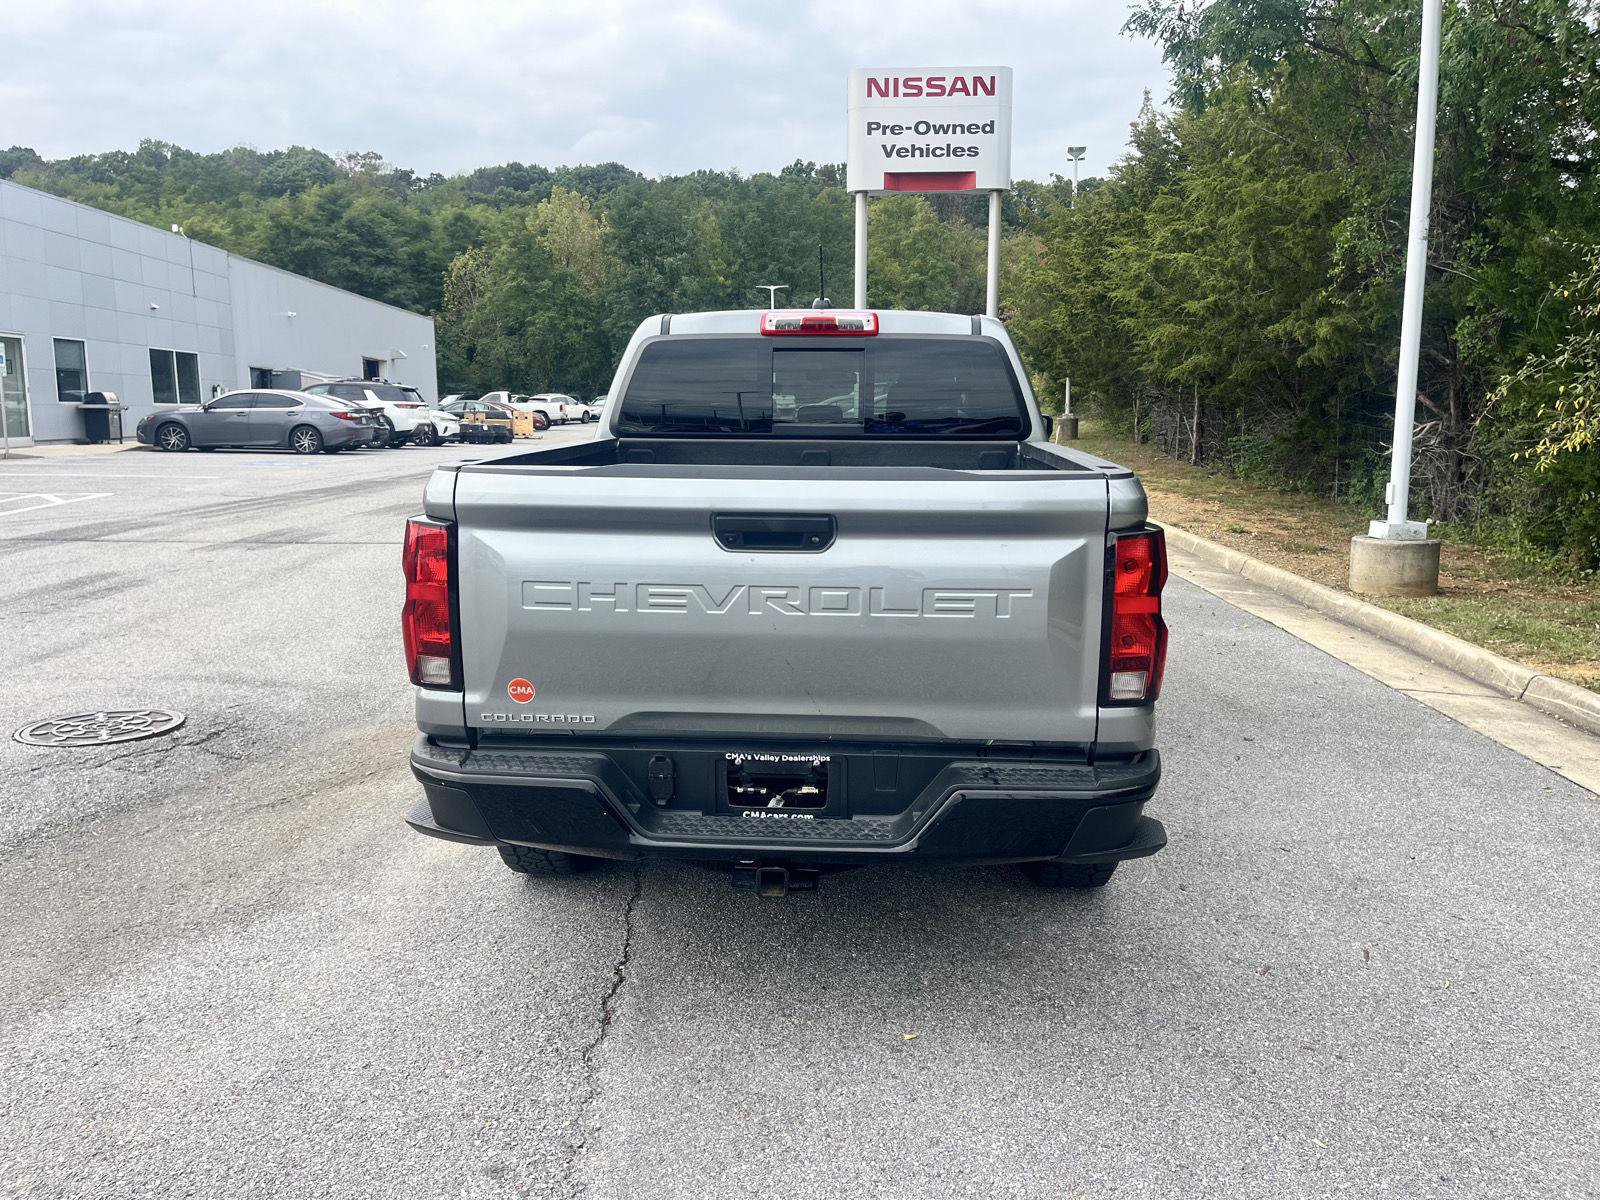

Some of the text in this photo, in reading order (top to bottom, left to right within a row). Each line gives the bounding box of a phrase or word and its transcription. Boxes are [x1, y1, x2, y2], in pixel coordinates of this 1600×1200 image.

[867, 76, 995, 98] NISSAN
[867, 120, 995, 136] Pre-Owned
[881, 143, 979, 158] Vehicles
[521, 580, 1034, 619] CHEVROLET
[510, 686, 534, 694] CMA
[480, 713, 596, 723] COLORADO
[754, 754, 780, 762] Valley
[782, 754, 831, 762] Dealerships
